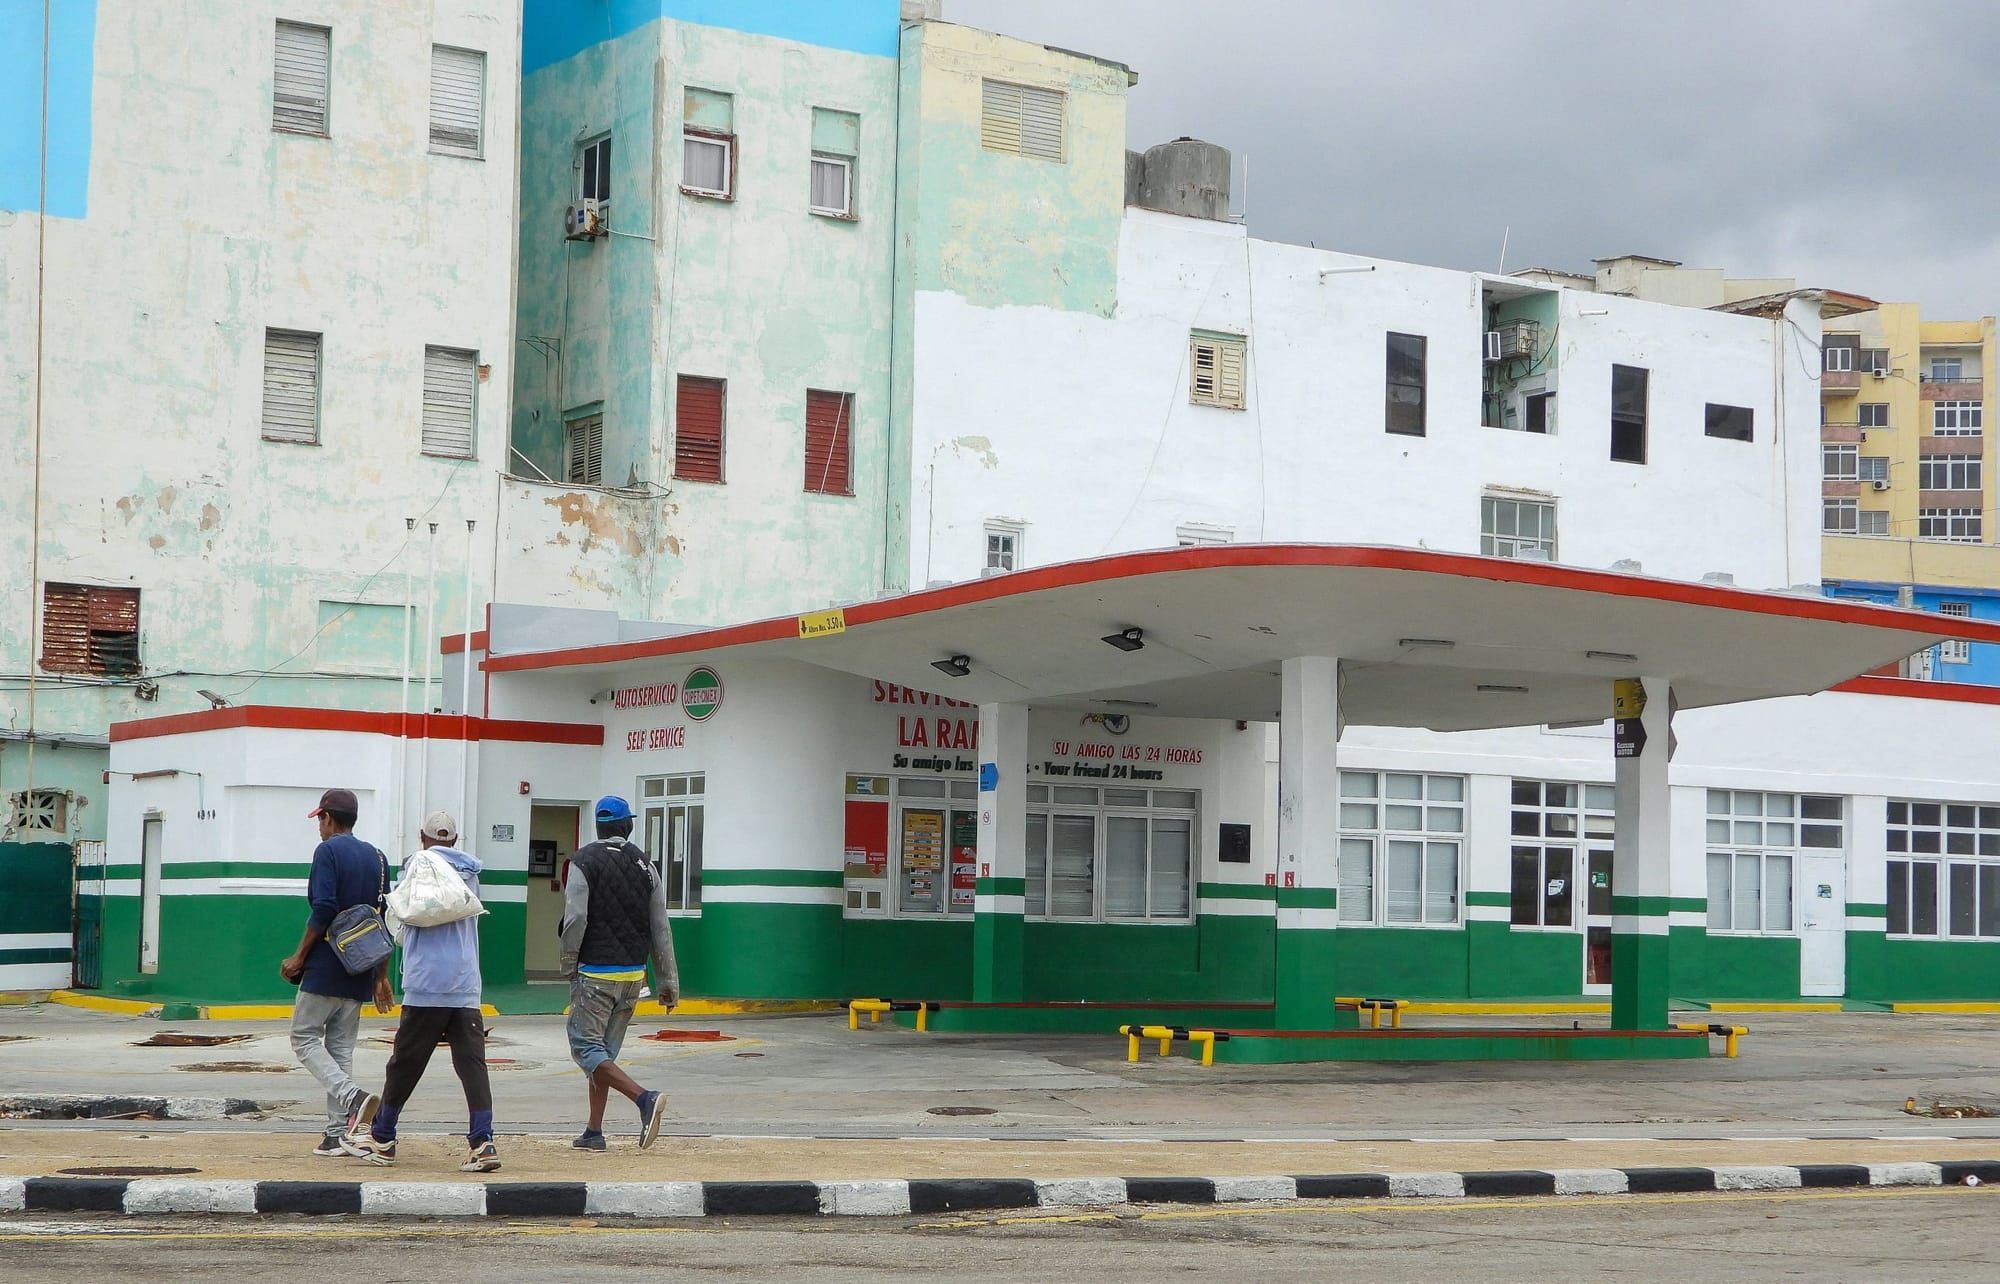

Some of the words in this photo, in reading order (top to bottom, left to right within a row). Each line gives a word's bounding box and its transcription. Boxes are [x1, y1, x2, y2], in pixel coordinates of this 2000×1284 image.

[614, 683, 677, 709] AUTOSERVICIO
[626, 730, 646, 752] SELF
[649, 726, 685, 749] SERVICE
[899, 716, 929, 748] LA
[893, 753, 908, 768] Su
[912, 755, 952, 772] amigo
[954, 756, 974, 771] las
[1054, 742, 1070, 756] SU
[1077, 743, 1115, 759] AMIGO
[1121, 746, 1140, 760] LAS
[1146, 747, 1160, 761] 24
[1165, 748, 1203, 764] HORAS
[1044, 761, 1071, 776] Your
[1073, 762, 1110, 778] friend
[1112, 765, 1128, 779] 24
[1130, 765, 1163, 781] hours
